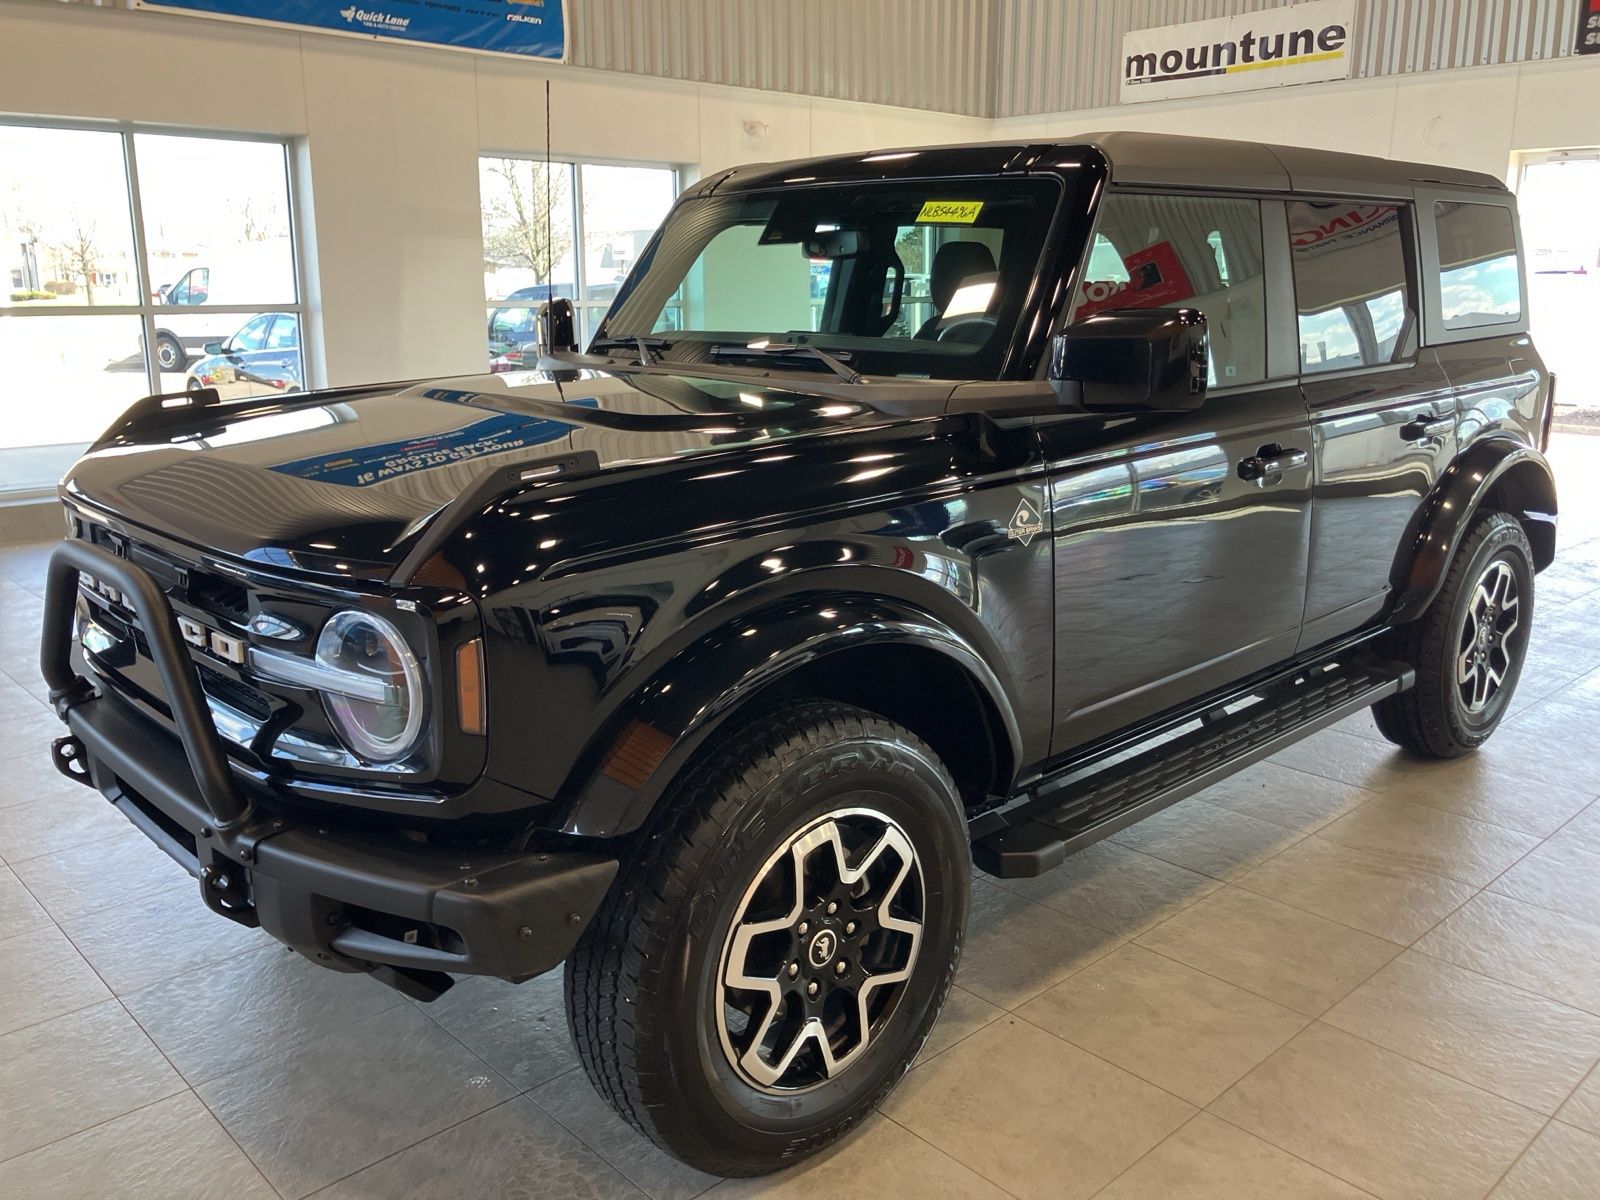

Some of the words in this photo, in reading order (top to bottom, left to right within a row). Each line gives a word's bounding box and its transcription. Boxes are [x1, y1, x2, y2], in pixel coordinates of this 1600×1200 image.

[355, 9, 385, 23] Quick
[385, 14, 410, 27] Lane
[507, 14, 541, 25] FALKEN
[1126, 24, 1346, 78] mountune
